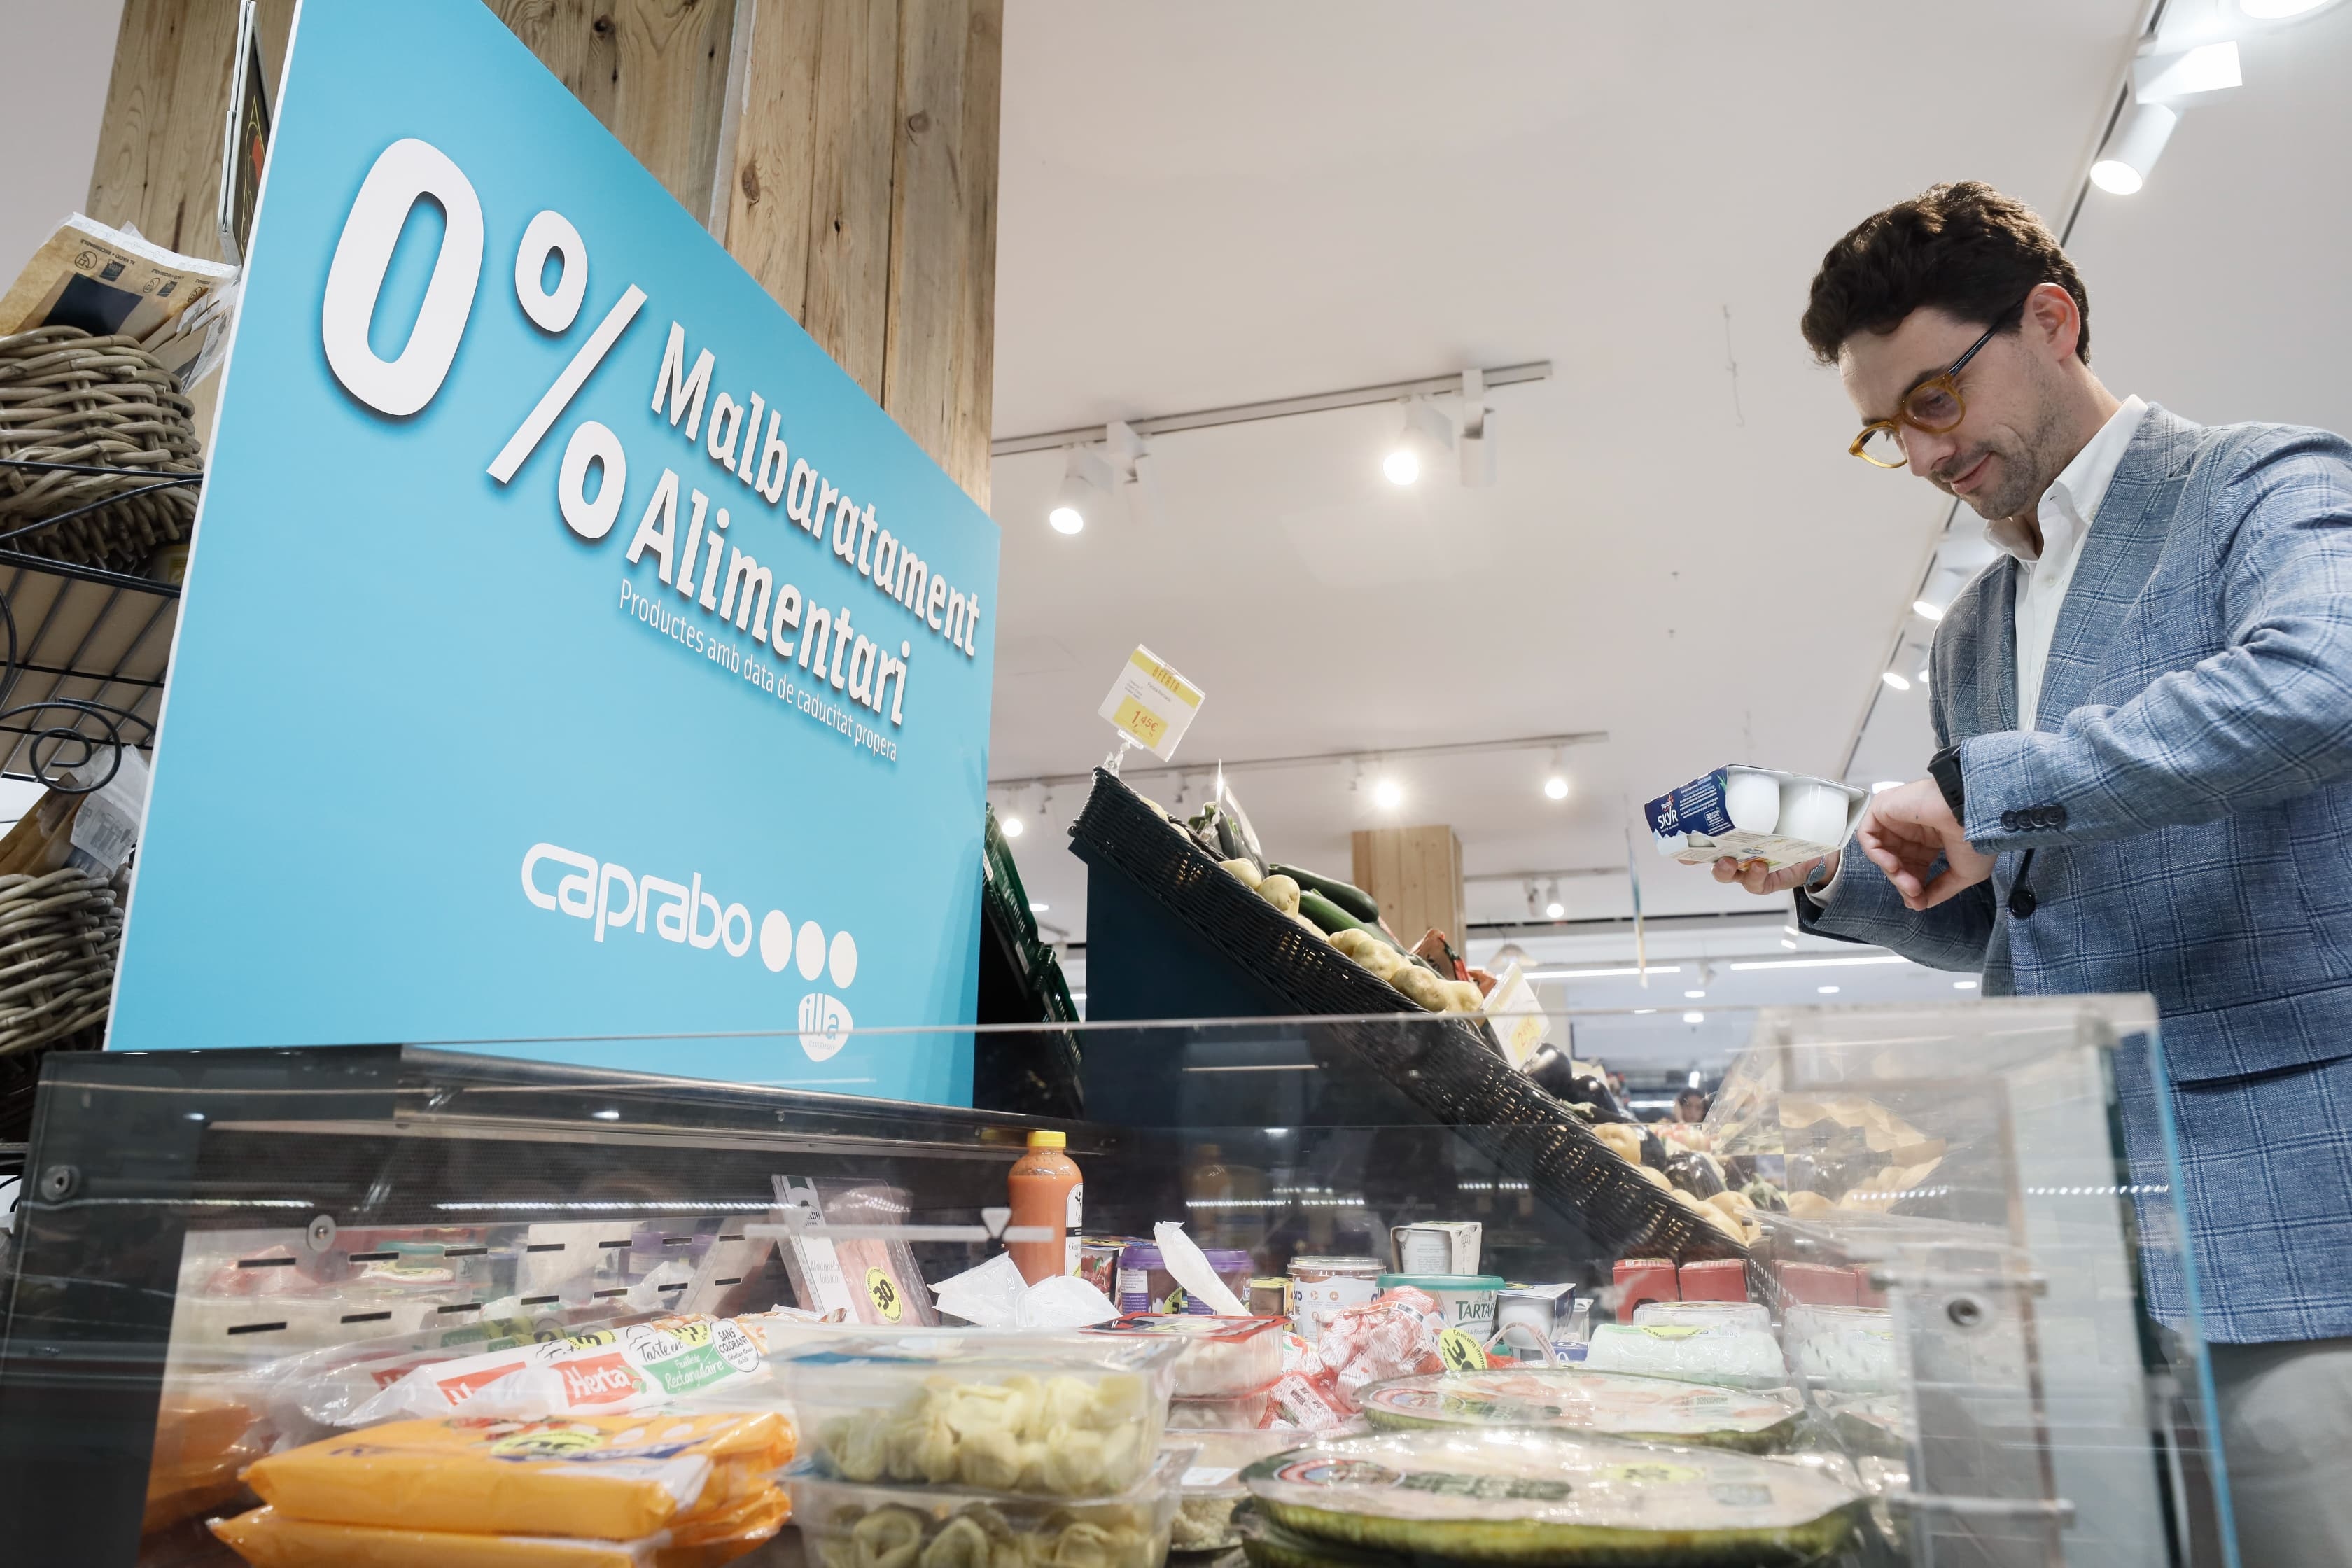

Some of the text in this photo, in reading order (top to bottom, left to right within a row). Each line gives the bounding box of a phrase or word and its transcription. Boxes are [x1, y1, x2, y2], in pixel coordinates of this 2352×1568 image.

[323, 139, 646, 538] 0%
[652, 323, 980, 657] Malbaratament
[626, 469, 910, 725] Alimentari
[620, 579, 897, 762] Productes amb data de caducitat propera
[1657, 805, 1679, 830] SKYR
[522, 843, 752, 957] caprabo
[804, 993, 839, 1040] illa
[636, 1340, 684, 1363] Tarte en
[718, 1326, 736, 1342] SANS
[718, 1335, 750, 1354] COLORANT
[1452, 1329, 1476, 1348] Consum
[564, 1364, 631, 1399] Herta
